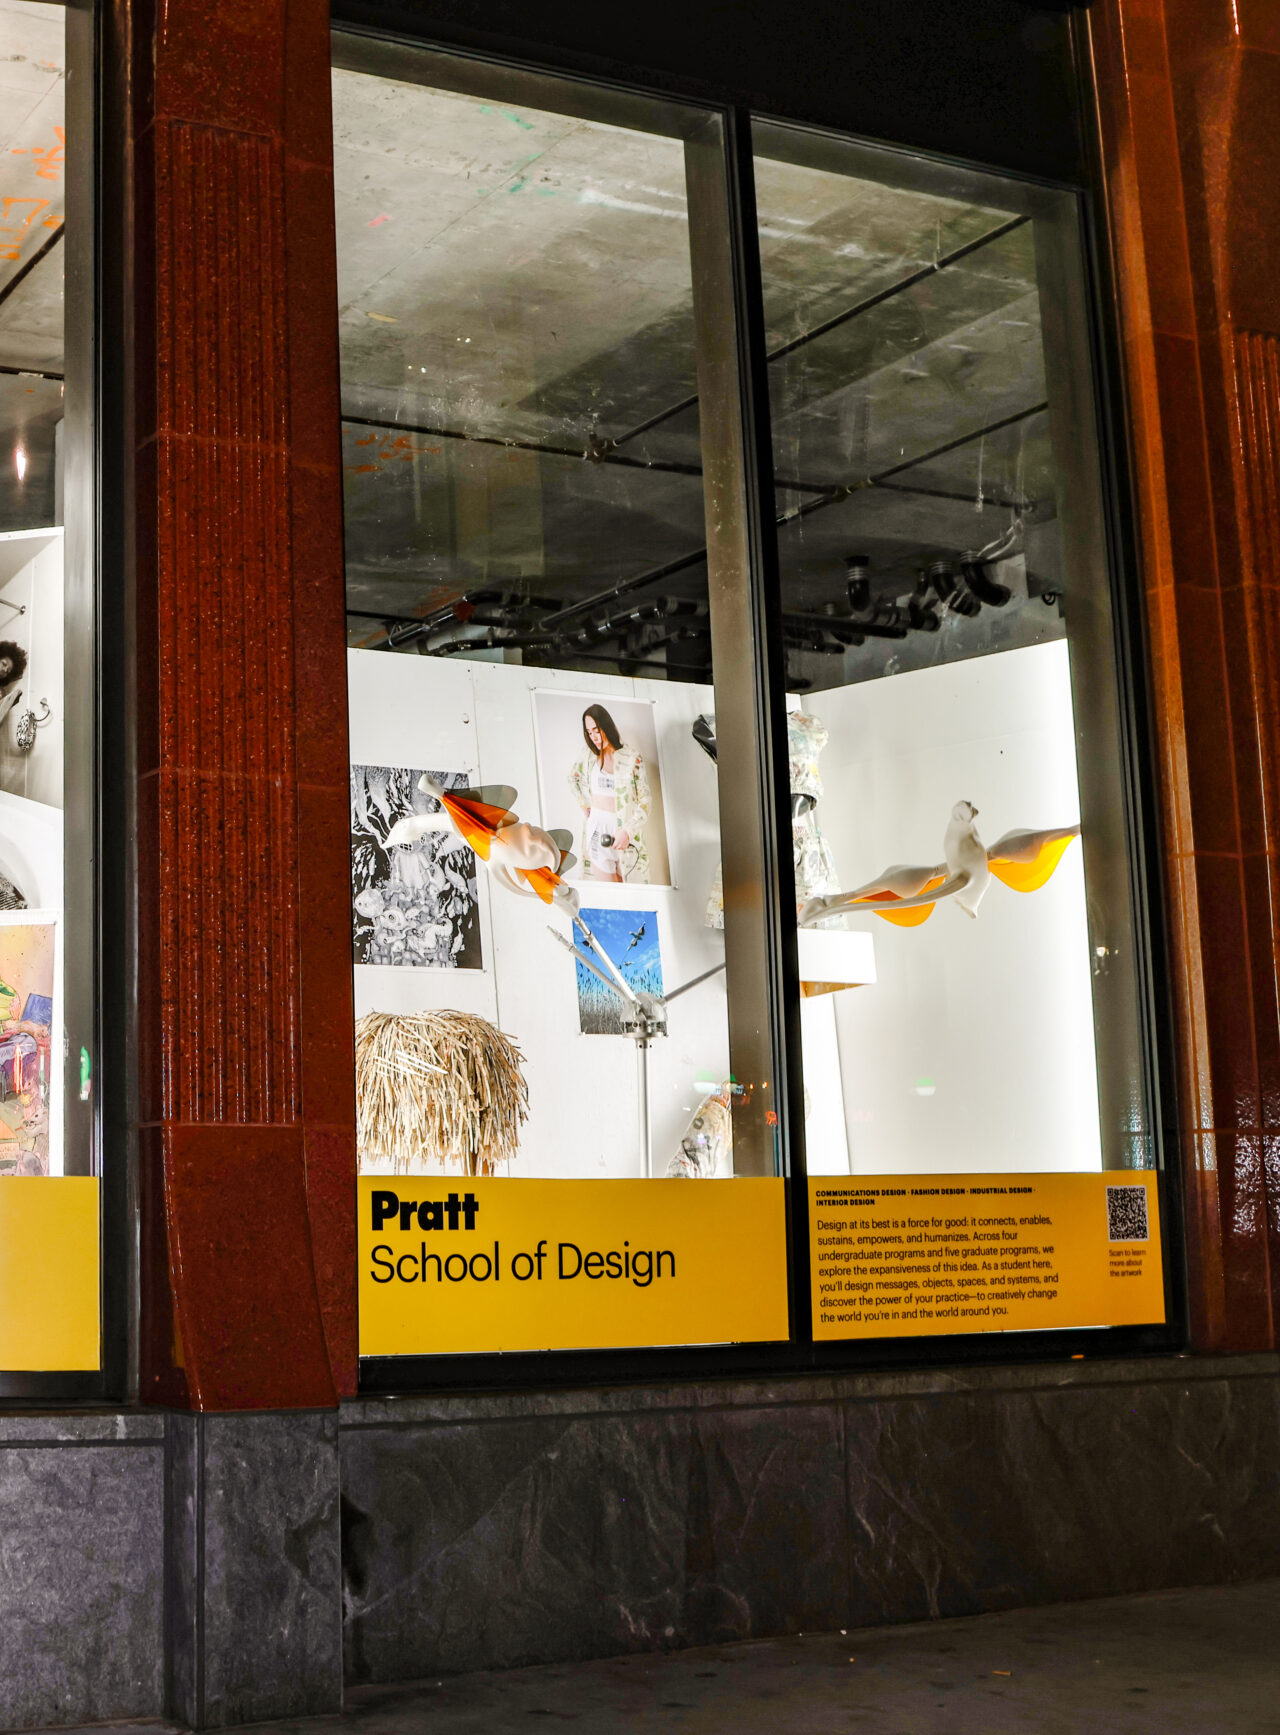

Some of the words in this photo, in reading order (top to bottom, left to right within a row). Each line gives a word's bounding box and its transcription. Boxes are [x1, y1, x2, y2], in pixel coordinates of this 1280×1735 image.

[371, 1190, 479, 1231] Pratt
[817, 1220, 847, 1232] Design
[850, 1221, 857, 1229] at
[860, 1219, 869, 1229] its
[872, 1219, 890, 1229] best
[892, 1218, 899, 1228] is
[908, 1218, 929, 1228] force
[932, 1217, 942, 1228] for
[945, 1217, 968, 1229] good:
[971, 1217, 976, 1226] it
[978, 1217, 1017, 1227] connects,
[1020, 1215, 1052, 1225] enables,
[818, 1236, 855, 1246] sustains,
[857, 1235, 904, 1246] empowers,
[906, 1233, 922, 1243] and
[924, 1231, 970, 1242] humanizes.
[973, 1231, 1000, 1241] Across
[1002, 1230, 1018, 1240] four
[818, 1249, 882, 1262] undergraduate
[884, 1249, 925, 1260] programs
[927, 1248, 943, 1258] and
[945, 1247, 959, 1257] five
[961, 1246, 998, 1258] graduate
[1000, 1246, 1040, 1256] programs,
[370, 1241, 500, 1283] School
[511, 1240, 548, 1281] of
[558, 1240, 675, 1287] Design
[819, 1265, 851, 1278] explore
[853, 1265, 867, 1275] the
[869, 1264, 931, 1276] expansiveness
[932, 1262, 941, 1272] of
[943, 1262, 958, 1272] this
[960, 1262, 979, 1271] idea.
[982, 1261, 992, 1270] As
[1000, 1260, 1030, 1270] student
[1032, 1259, 1052, 1269] here,
[819, 1281, 842, 1293] you'll
[844, 1280, 873, 1292] design
[876, 1281, 920, 1290] messages,
[922, 1278, 955, 1290] objects,
[957, 1277, 988, 1287] spaces,
[990, 1275, 1005, 1285] and
[1007, 1275, 1041, 1286] systems,
[1043, 1273, 1058, 1283] and
[820, 1297, 856, 1307] discover
[859, 1295, 873, 1305] the
[875, 1297, 902, 1307] power
[904, 1293, 912, 1303] of
[915, 1295, 933, 1304] your
[987, 1289, 1025, 1300] creatively
[1027, 1289, 1057, 1299] change
[821, 1312, 835, 1323] the
[837, 1311, 861, 1321] world
[864, 1310, 889, 1322] you're
[892, 1309, 899, 1319] in
[902, 1308, 917, 1319] and
[919, 1308, 933, 1318] the
[935, 1306, 958, 1317] world
[961, 1305, 989, 1316] around
[992, 1306, 1008, 1316] you.
